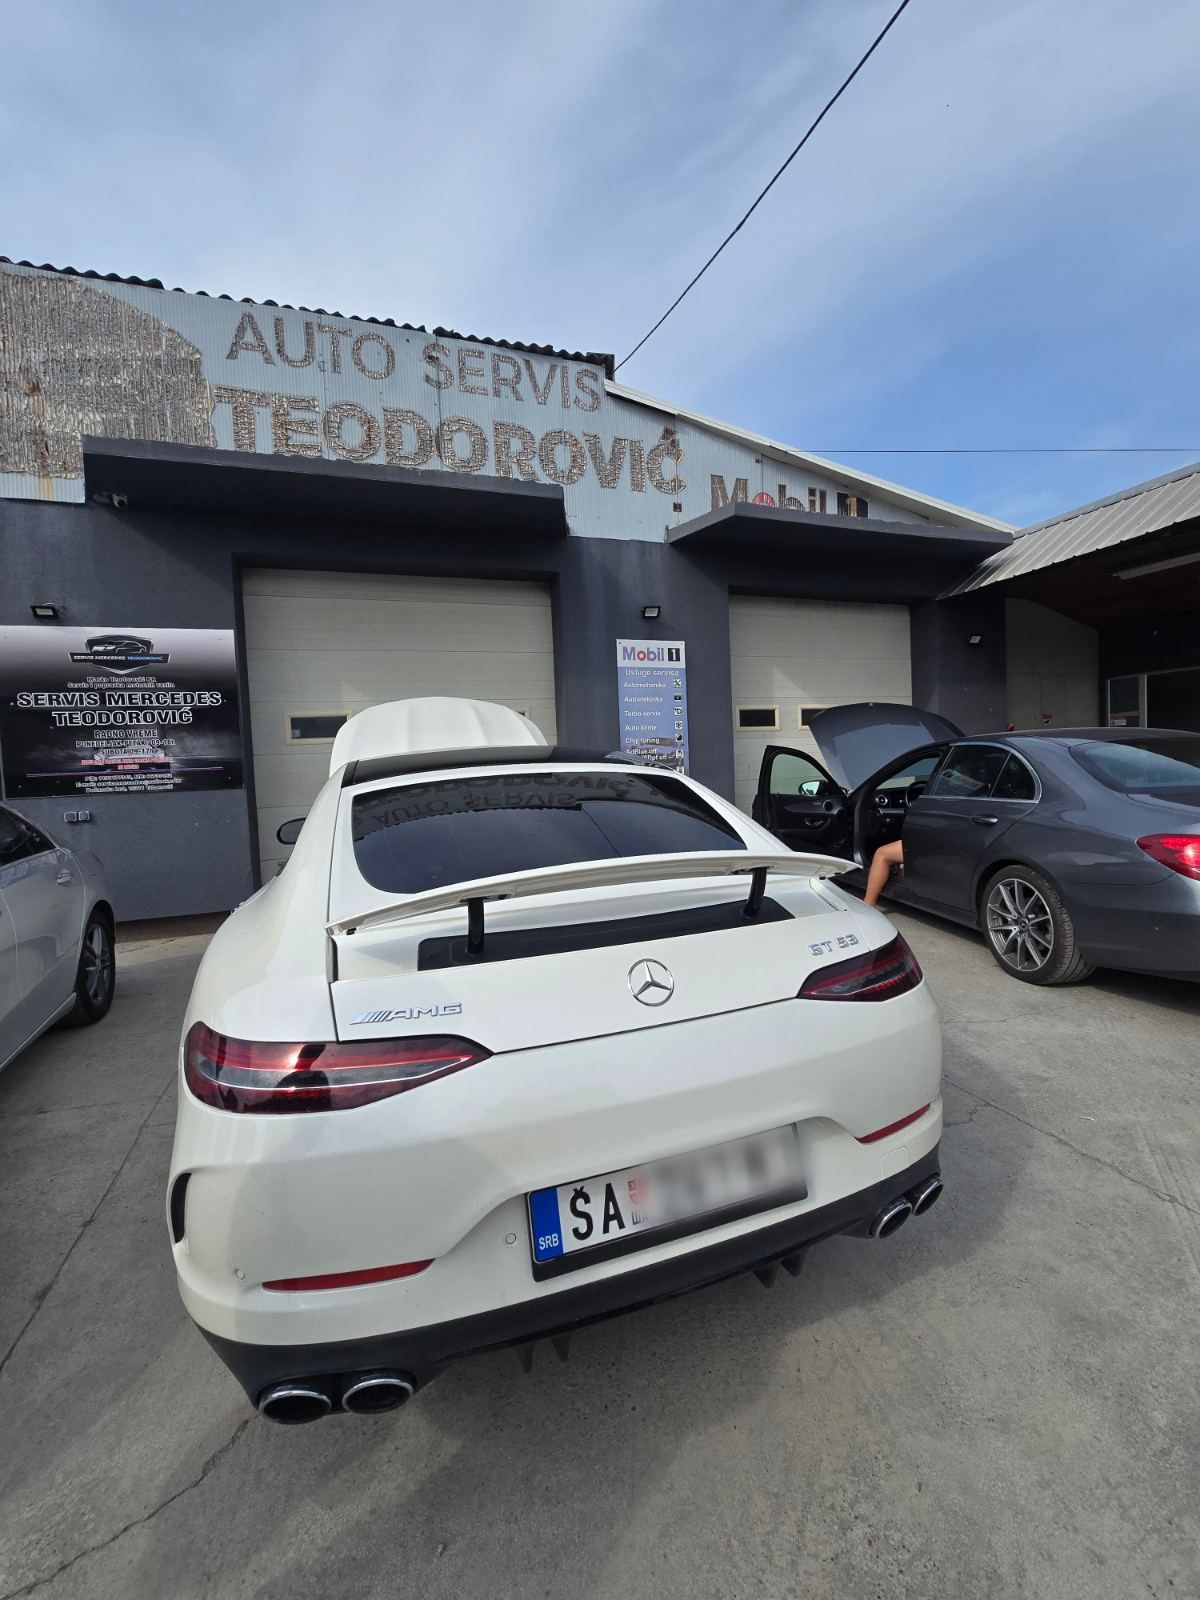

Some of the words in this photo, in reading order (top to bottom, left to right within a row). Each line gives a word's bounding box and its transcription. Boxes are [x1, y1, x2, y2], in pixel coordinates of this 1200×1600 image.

[226, 312, 396, 380] AUTO
[422, 343, 601, 412] SERVIS
[213, 384, 687, 495] TEODOROVIĆ
[622, 646, 665, 662] Mobil
[625, 668, 651, 677] Usluge
[17, 692, 100, 707] SERVIS
[105, 692, 222, 706] MERCEDES
[52, 707, 193, 727] TEODOROVIĆ
[94, 729, 125, 738] RADNO
[127, 729, 158, 738] VREME
[808, 940, 833, 956] GT
[834, 934, 859, 949] 53
[385, 1003, 462, 1022] AMG
[569, 1183, 626, 1241] ŠA
[538, 1232, 560, 1251] SRB
